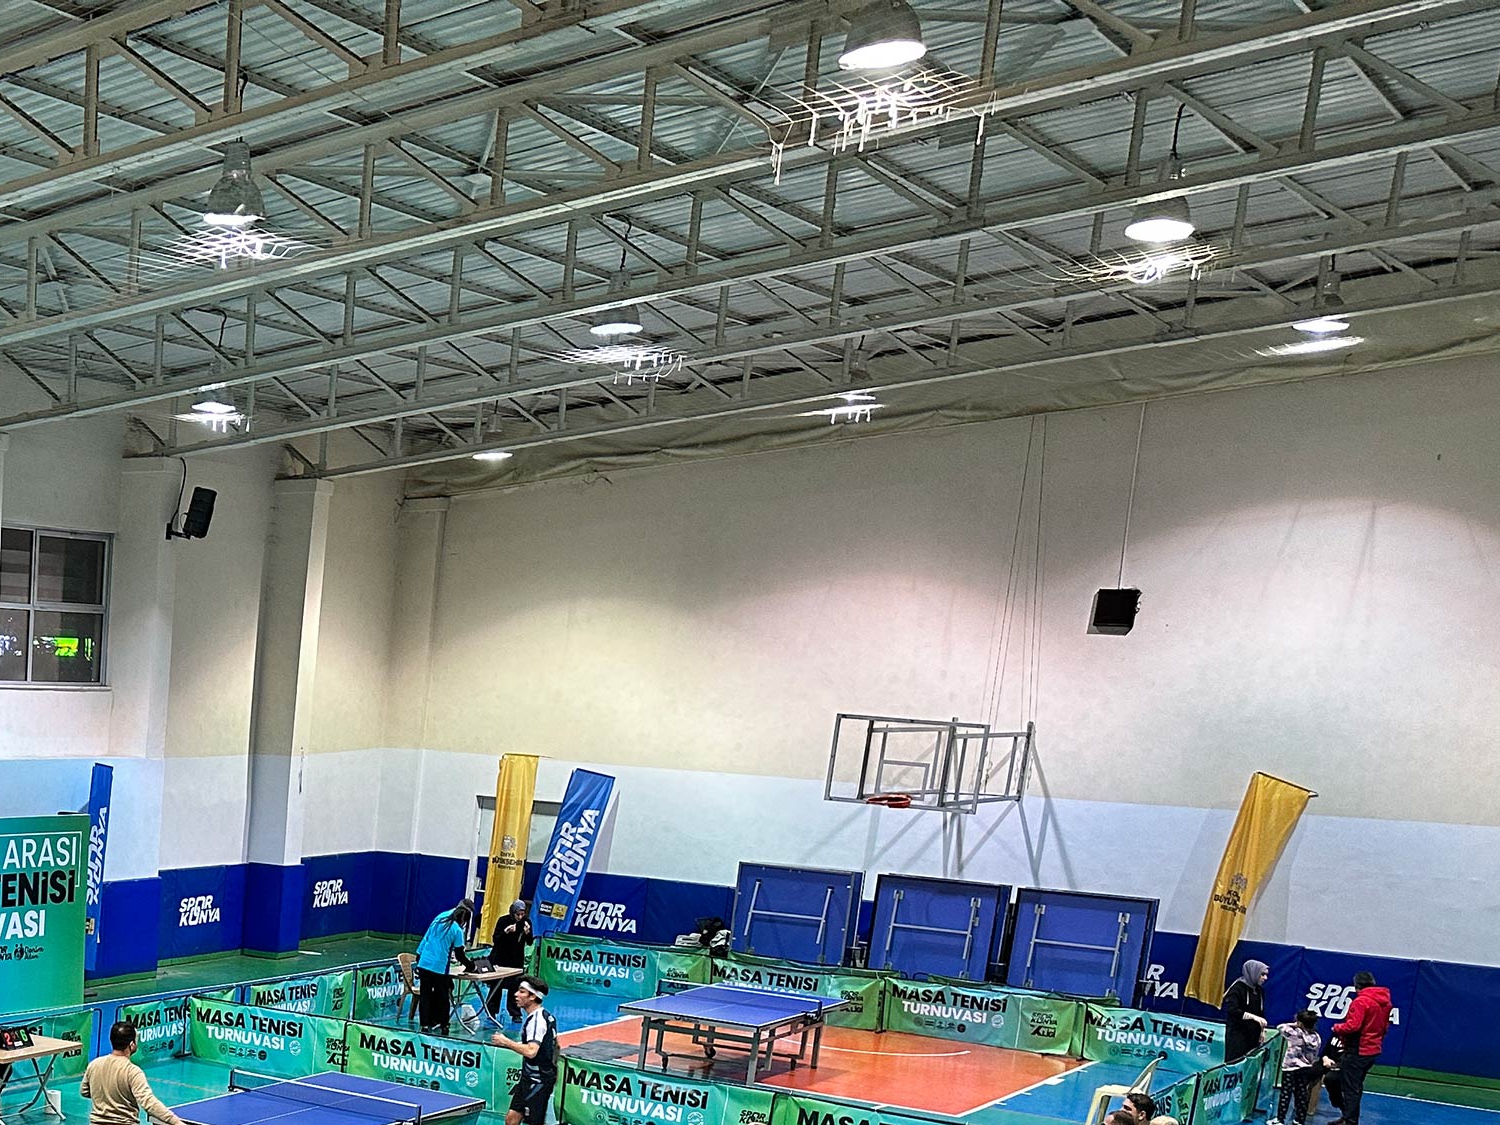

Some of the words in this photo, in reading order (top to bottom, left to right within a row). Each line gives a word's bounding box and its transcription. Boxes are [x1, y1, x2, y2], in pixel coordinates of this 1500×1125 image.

[3, 836, 77, 870] ARASI
[544, 821, 577, 893] SPOR
[560, 808, 601, 895] KONYA
[313, 879, 345, 900] SPOR
[313, 889, 349, 909] KONYA
[179, 895, 213, 917] SPOR
[179, 907, 221, 928] KONYA
[575, 899, 626, 918] SPOR
[574, 909, 637, 934] KONYA
[546, 945, 593, 965] MASA
[597, 951, 647, 969] TENİSİ
[361, 968, 393, 988] MASA
[555, 961, 630, 979] TURNUVASI
[712, 964, 763, 984] MASA
[767, 972, 818, 992] TENİSİ
[255, 988, 288, 1007] MASA
[891, 984, 945, 1005] MASA
[950, 992, 1008, 1014] TENİSİ
[195, 1008, 246, 1029] MASA
[250, 1014, 303, 1039] TENİSİ
[902, 1000, 987, 1024] TURNUVASI
[3, 1032, 13, 1046] 2
[19, 1029, 28, 1042] 6
[206, 1025, 285, 1051] TURNUVASI
[1096, 1028, 1191, 1053] TURNUVASI
[1150, 1020, 1215, 1044] TENİSİ
[359, 1032, 417, 1058] MASA
[421, 1043, 482, 1070] TENİSİ
[371, 1052, 460, 1083] TURNUVASI
[566, 1067, 633, 1094] MASA
[638, 1080, 709, 1110] TENİSİ
[580, 1089, 683, 1123] TURNUVASI
